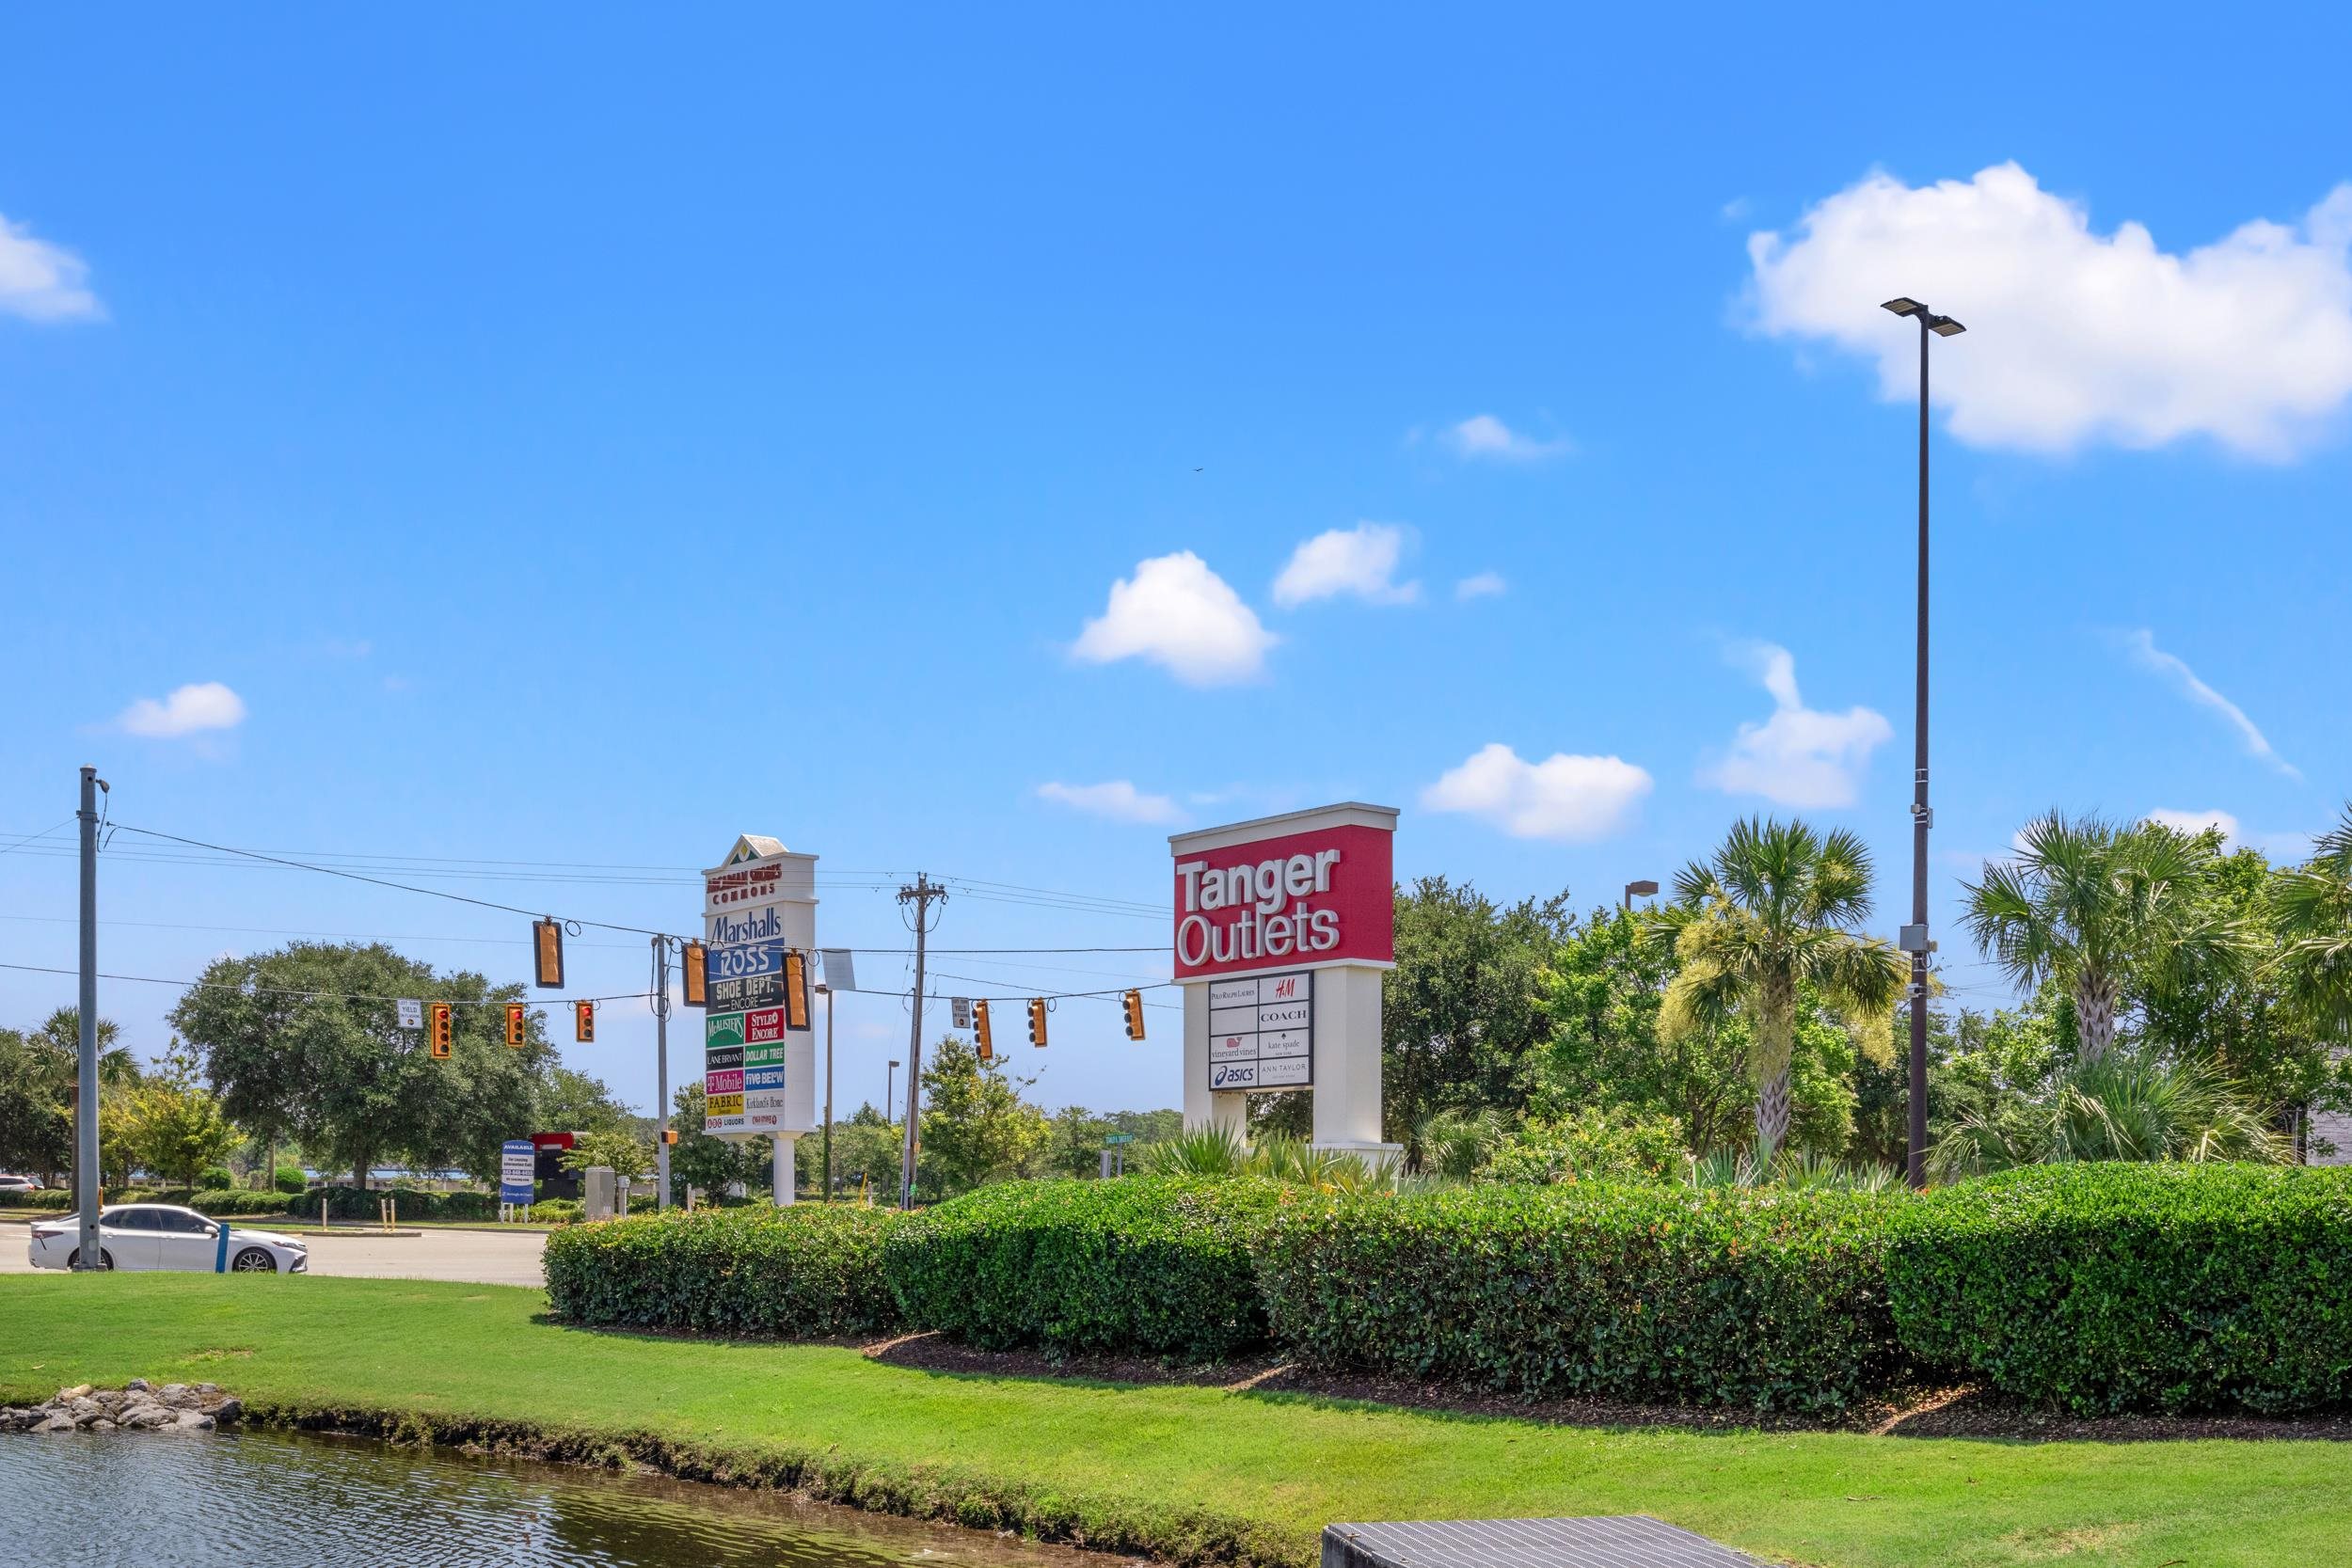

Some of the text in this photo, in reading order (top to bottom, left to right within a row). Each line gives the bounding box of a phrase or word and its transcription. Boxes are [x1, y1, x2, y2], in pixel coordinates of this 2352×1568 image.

[1176, 848, 1340, 914] Tanger
[713, 883, 774, 904] COMMONS
[712, 907, 781, 943] Marshalls
[1177, 902, 1340, 967] Outlets
[721, 943, 769, 976] ROSS
[717, 980, 741, 1000] SHOE
[1276, 978, 1295, 999] H&M
[731, 996, 758, 1010] ENCORE
[1261, 1010, 1307, 1022] COACH
[752, 1027, 778, 1040] ENCORE
[1282, 1039, 1300, 1050] spade
[707, 1053, 743, 1065] LANE BRYANT
[746, 1047, 784, 1062] DOLLAR TREE
[1212, 1047, 1256, 1059] vineyard vines
[1279, 1063, 1307, 1071] TAYLOR
[1227, 1068, 1254, 1082] asics
[709, 1095, 742, 1108] FABRIC
